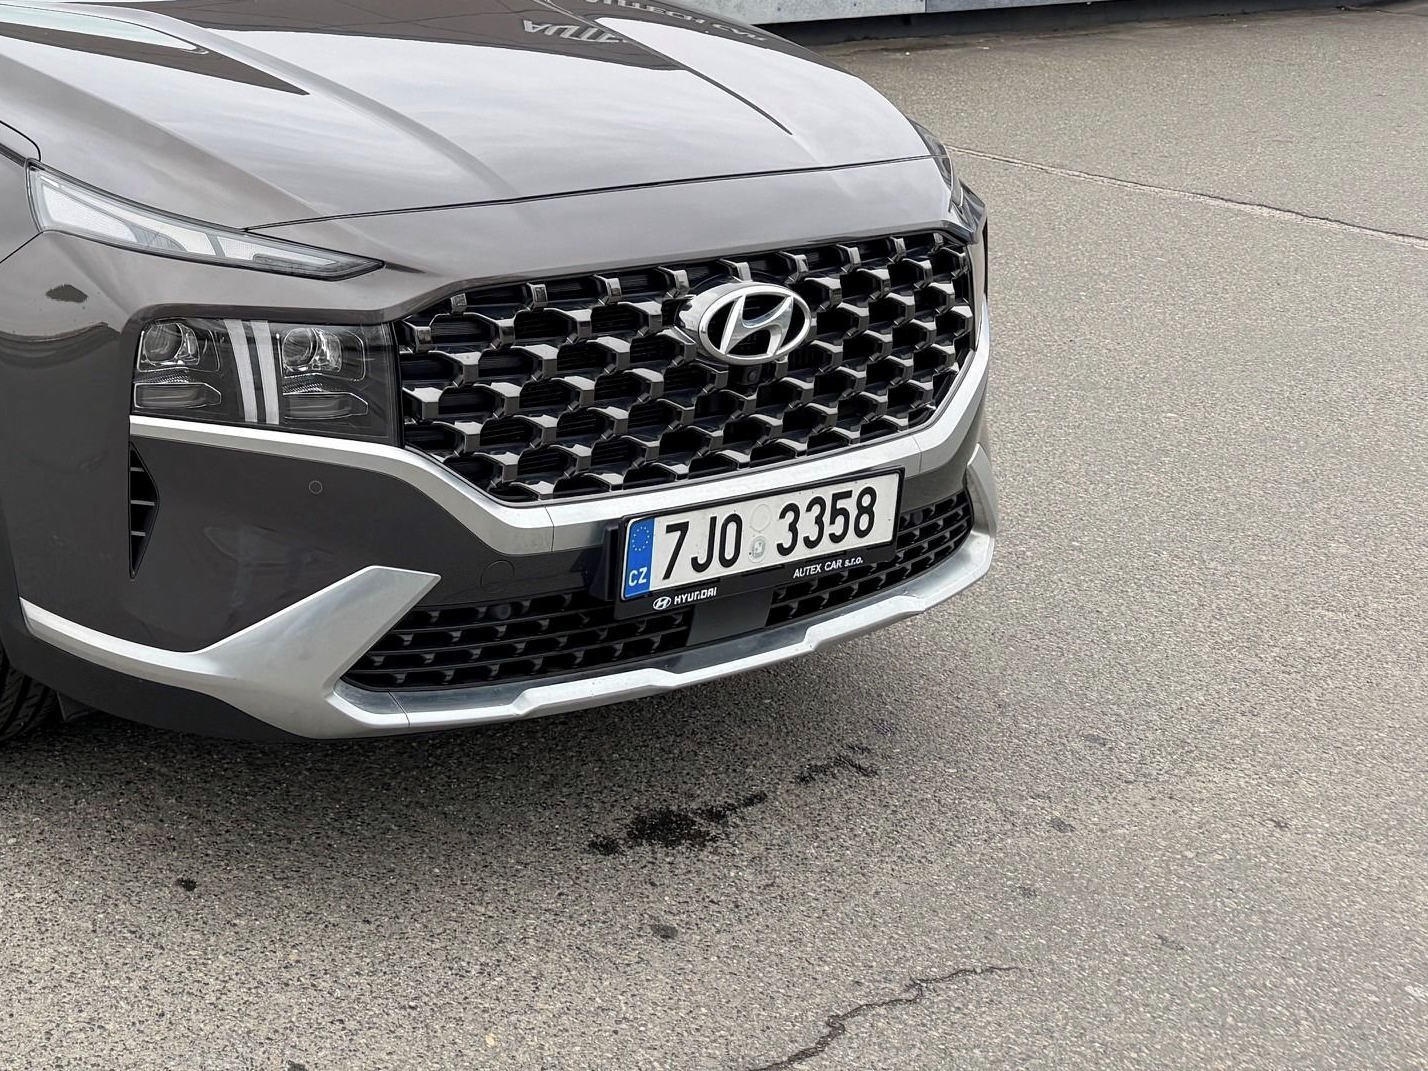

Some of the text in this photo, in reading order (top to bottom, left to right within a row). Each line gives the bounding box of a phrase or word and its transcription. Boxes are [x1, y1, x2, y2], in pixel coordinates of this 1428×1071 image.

[661, 485, 877, 581] 7J0 3358
[628, 566, 649, 587] CZ
[792, 556, 864, 579] AUTEX CAR s.r.o.
[674, 587, 717, 605] HYUNDAI
